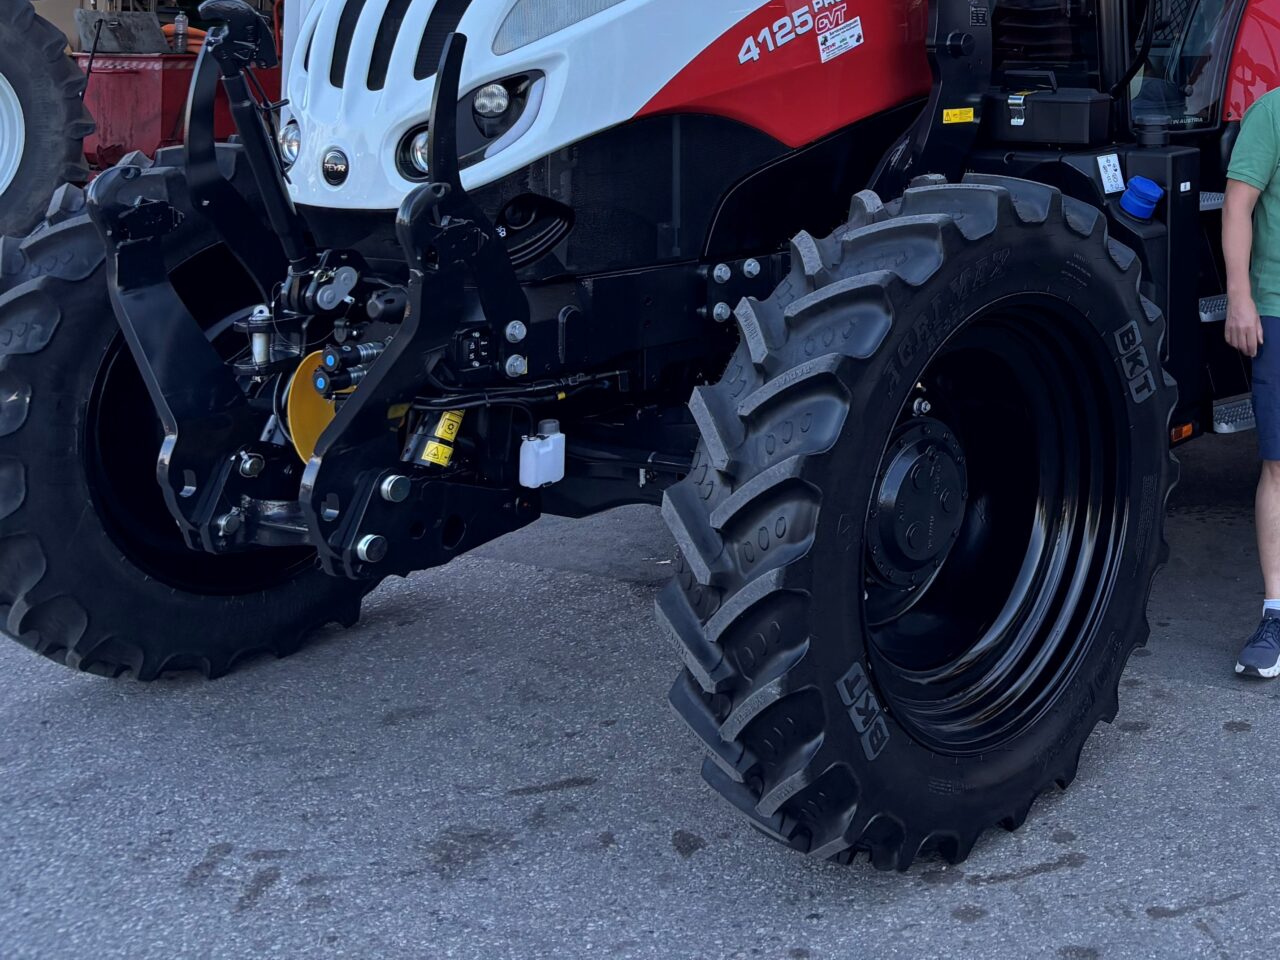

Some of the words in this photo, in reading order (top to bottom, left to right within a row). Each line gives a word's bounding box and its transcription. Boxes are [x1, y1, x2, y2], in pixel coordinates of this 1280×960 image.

[737, 6, 815, 65] 4125
[814, 3, 847, 34] CVT
[1114, 320, 1157, 404] BKT
[836, 662, 890, 761] BKT
